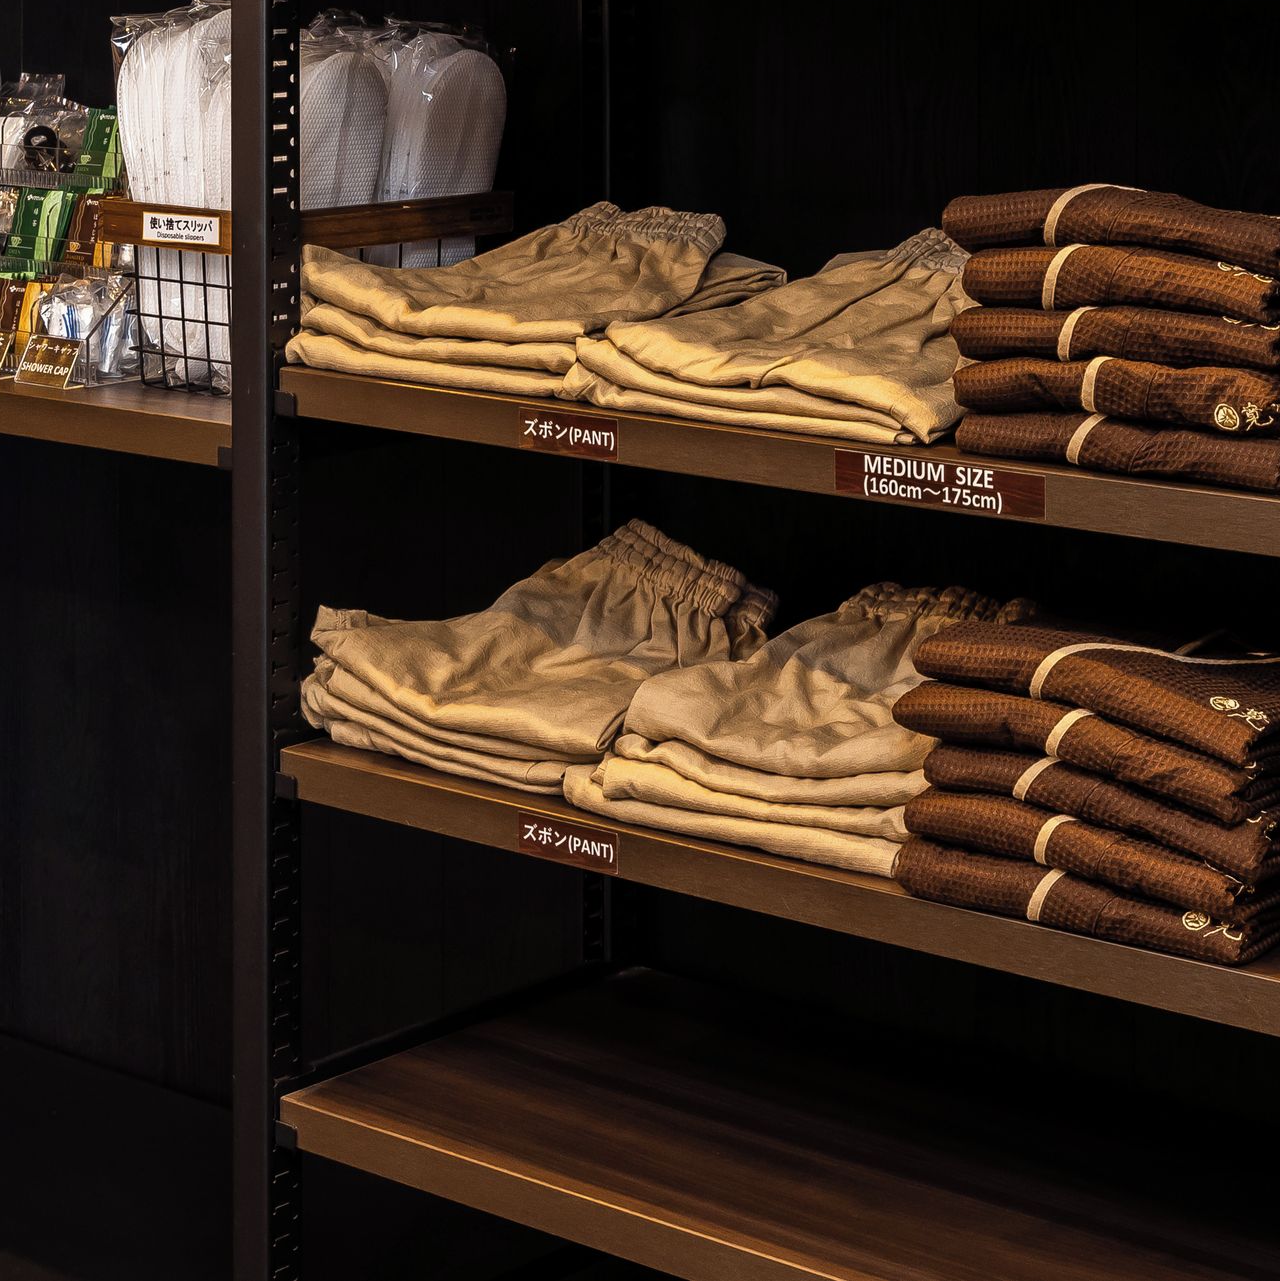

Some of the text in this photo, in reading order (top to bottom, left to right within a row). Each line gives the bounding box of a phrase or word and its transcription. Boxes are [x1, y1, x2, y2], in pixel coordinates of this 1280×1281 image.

[150, 216, 212, 232] 使い捨てスリッパ
[157, 231, 184, 240] Disposable
[21, 361, 69, 376] SHOWER CAP
[523, 418, 615, 451] ズボン(PANT)
[863, 453, 994, 489] MEDIUM SIZE
[523, 823, 613, 863] ズボン(PANT)
